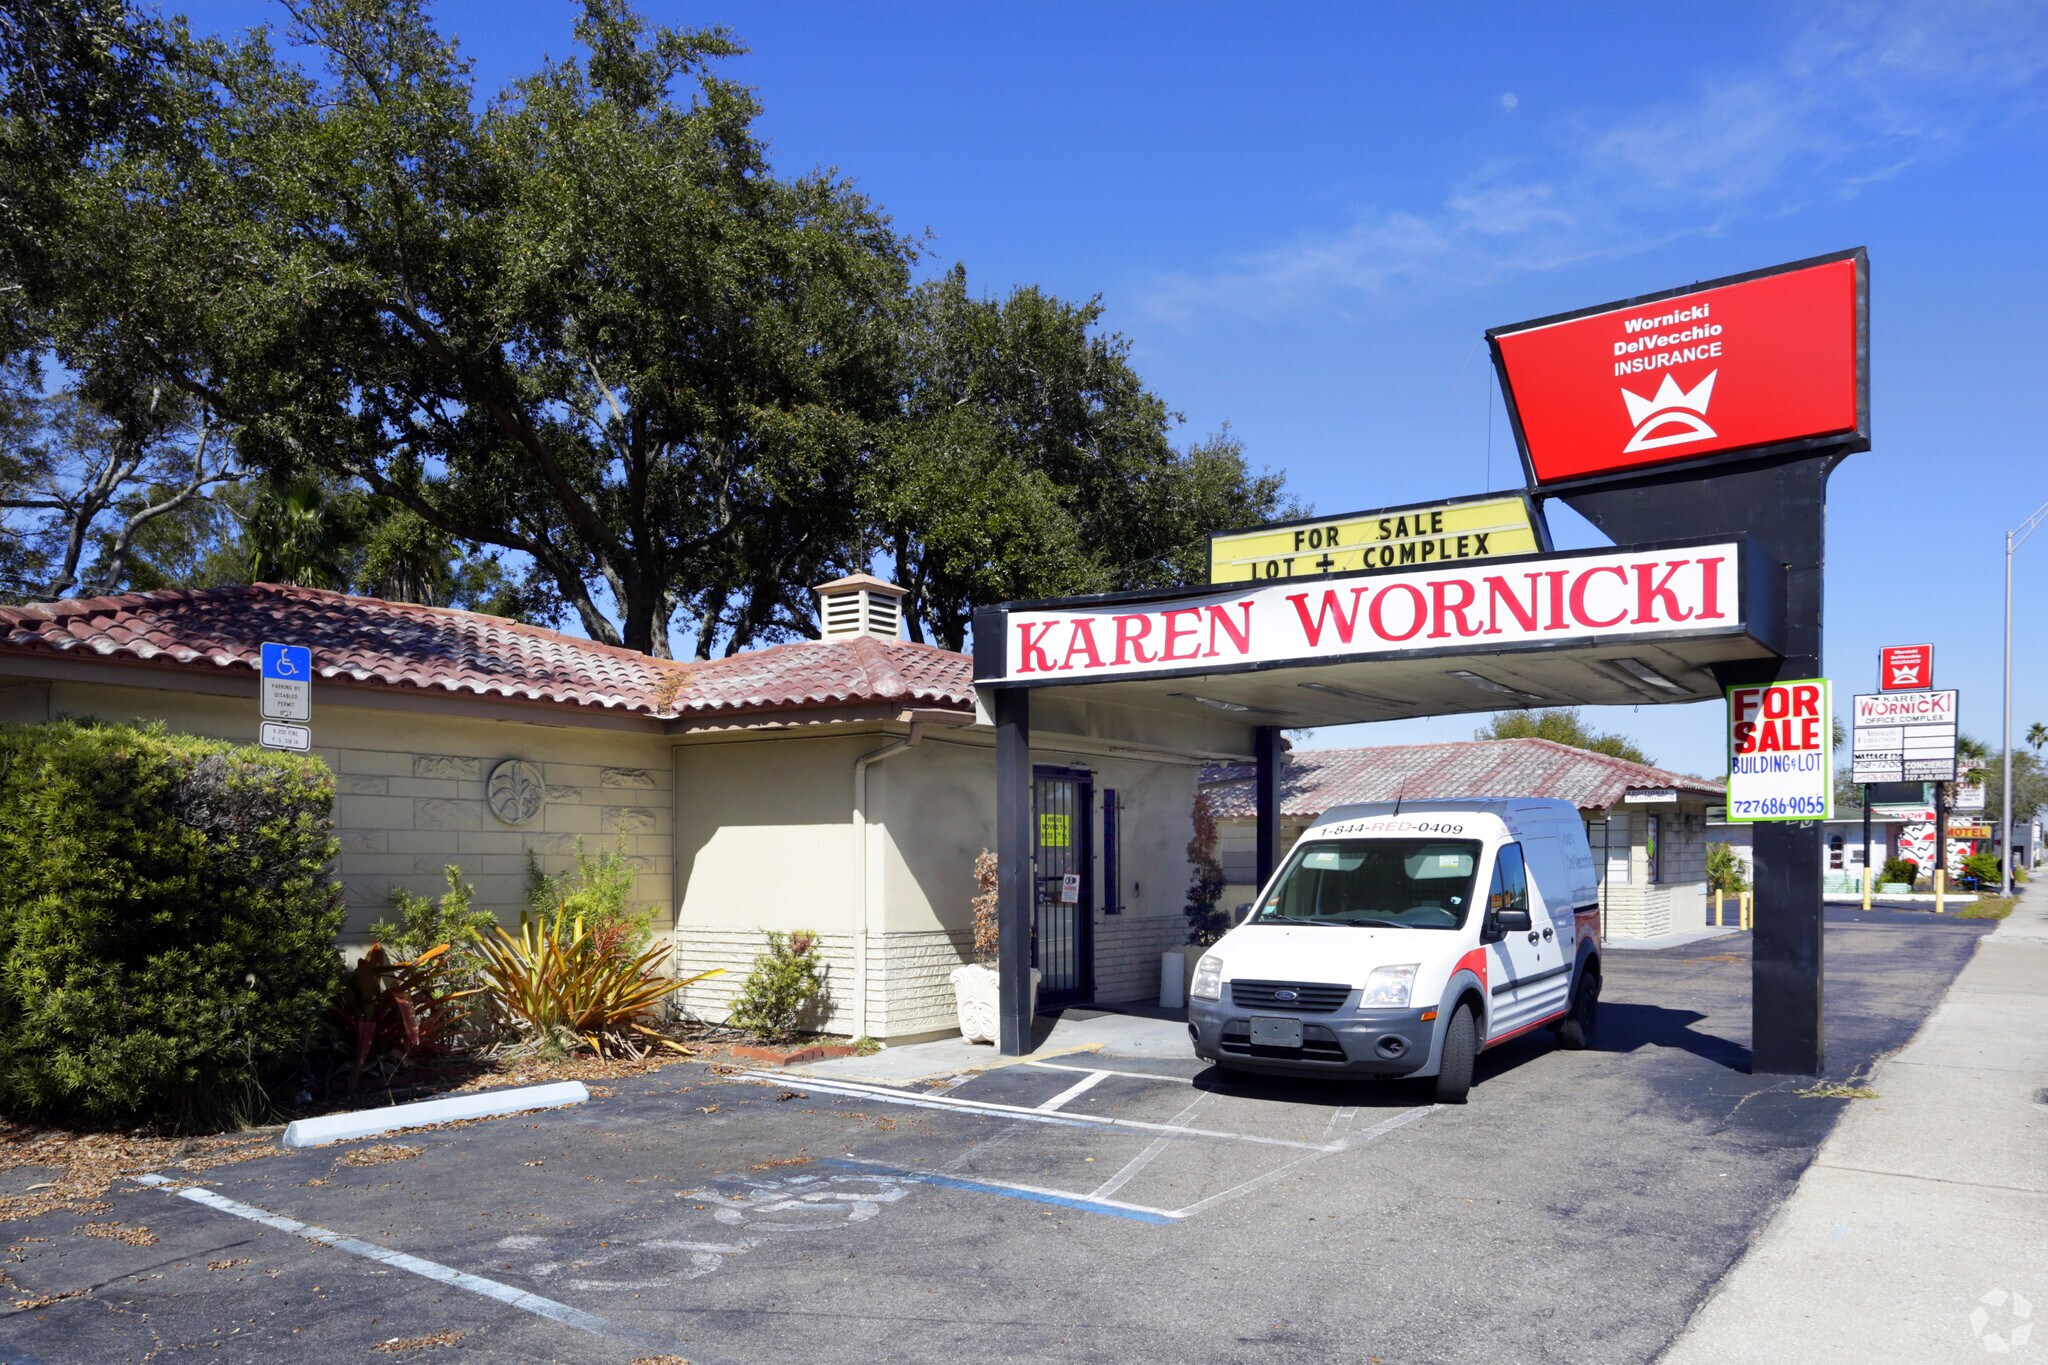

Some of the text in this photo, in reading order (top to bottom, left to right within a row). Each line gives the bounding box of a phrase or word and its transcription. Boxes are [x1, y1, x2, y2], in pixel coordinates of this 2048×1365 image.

[1624, 303, 1710, 334] Wornicki
[1613, 323, 1723, 356] DelVecchio
[1614, 342, 1723, 376] INSURANCE
[1294, 511, 1444, 552] FOR SALE
[1252, 533, 1490, 581] LOT + COMPLEX
[1015, 556, 1726, 673] KAREN WORNICKI
[274, 692, 298, 700] DISABLED
[1733, 685, 1820, 722] FOR
[1860, 693, 1951, 717] WORNICKI
[1883, 694, 1927, 703] KAREN
[1865, 714, 1944, 725] OFFICE COMPLEX
[1734, 718, 1820, 755] SALE
[1321, 821, 1464, 837] 1-844-RED-0409
[1947, 827, 1987, 837] MOTEL
